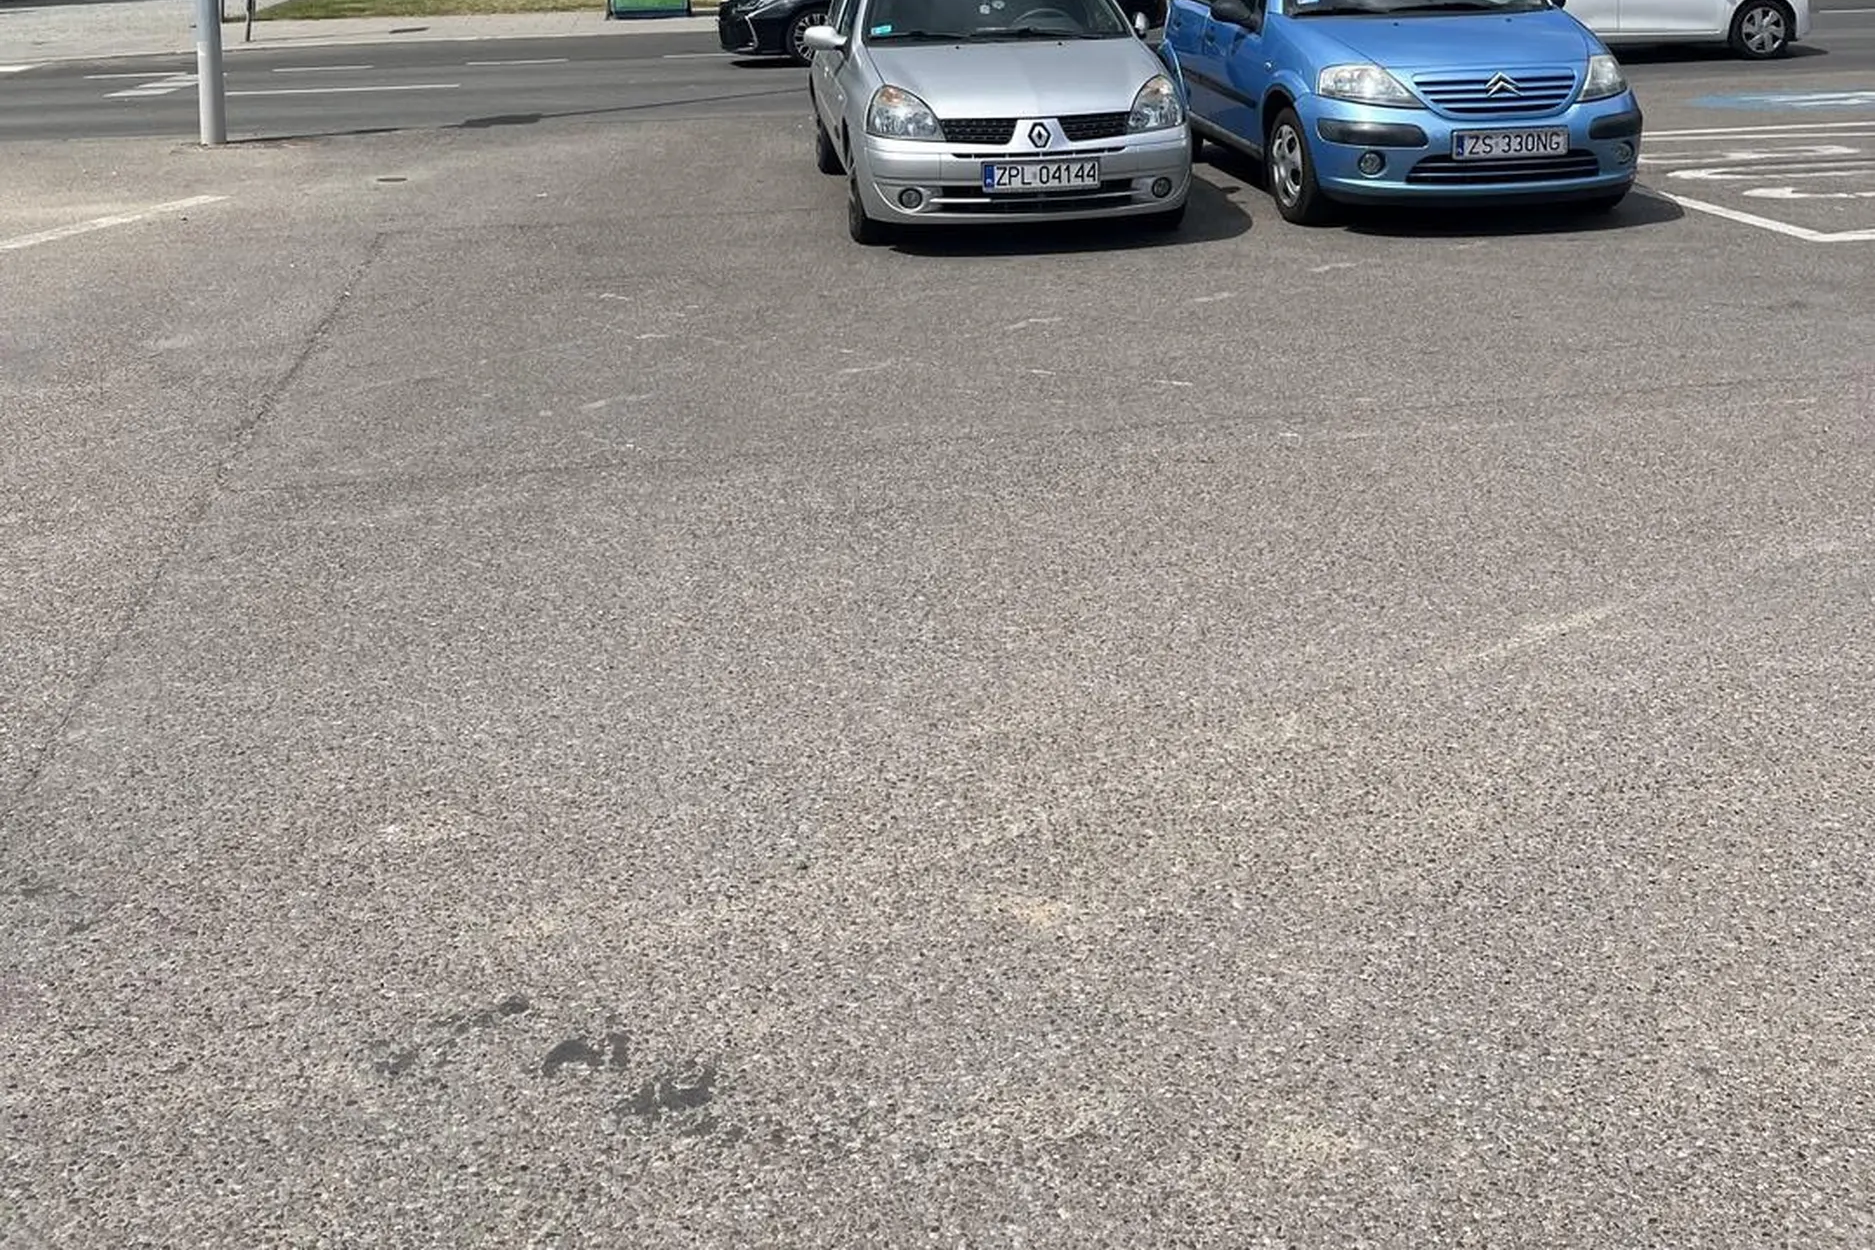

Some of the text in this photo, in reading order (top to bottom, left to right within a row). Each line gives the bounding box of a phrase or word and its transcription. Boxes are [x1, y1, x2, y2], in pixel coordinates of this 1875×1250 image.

[1468, 131, 1560, 155] ZS 330NG
[996, 162, 1096, 186] ZPL 04144
